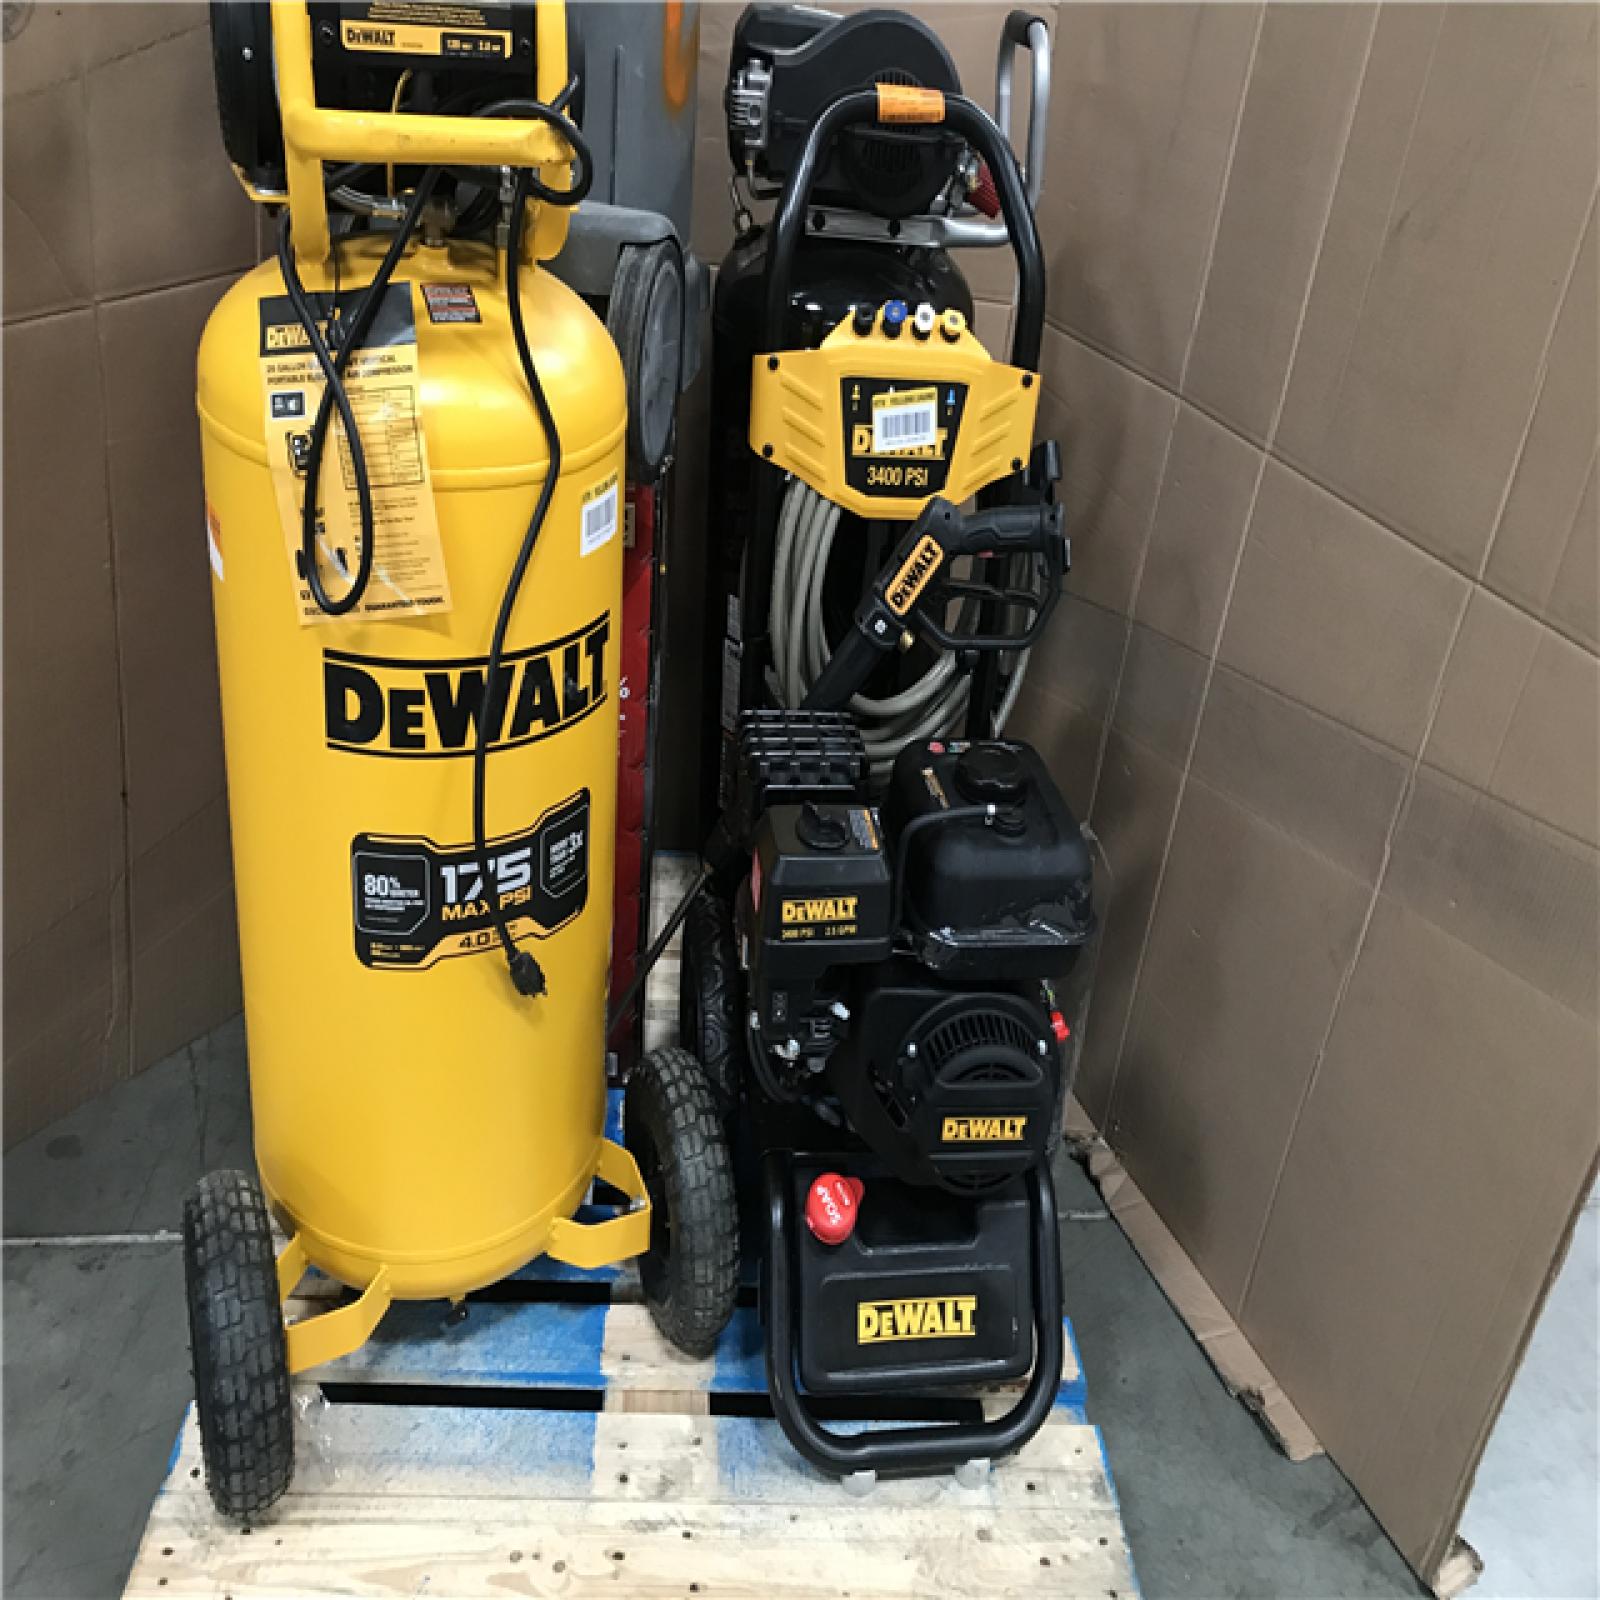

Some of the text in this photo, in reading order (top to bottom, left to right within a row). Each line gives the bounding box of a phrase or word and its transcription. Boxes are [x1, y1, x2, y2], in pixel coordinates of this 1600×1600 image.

[866, 466, 929, 487] 3400 PSI
[890, 543, 937, 608] DEWALT
[324, 620, 609, 750] DEWALT
[440, 847, 532, 904] 175
[782, 898, 858, 922] DEWALT
[943, 1117, 1027, 1141] DEWALT
[857, 1295, 977, 1345] DEWALT
